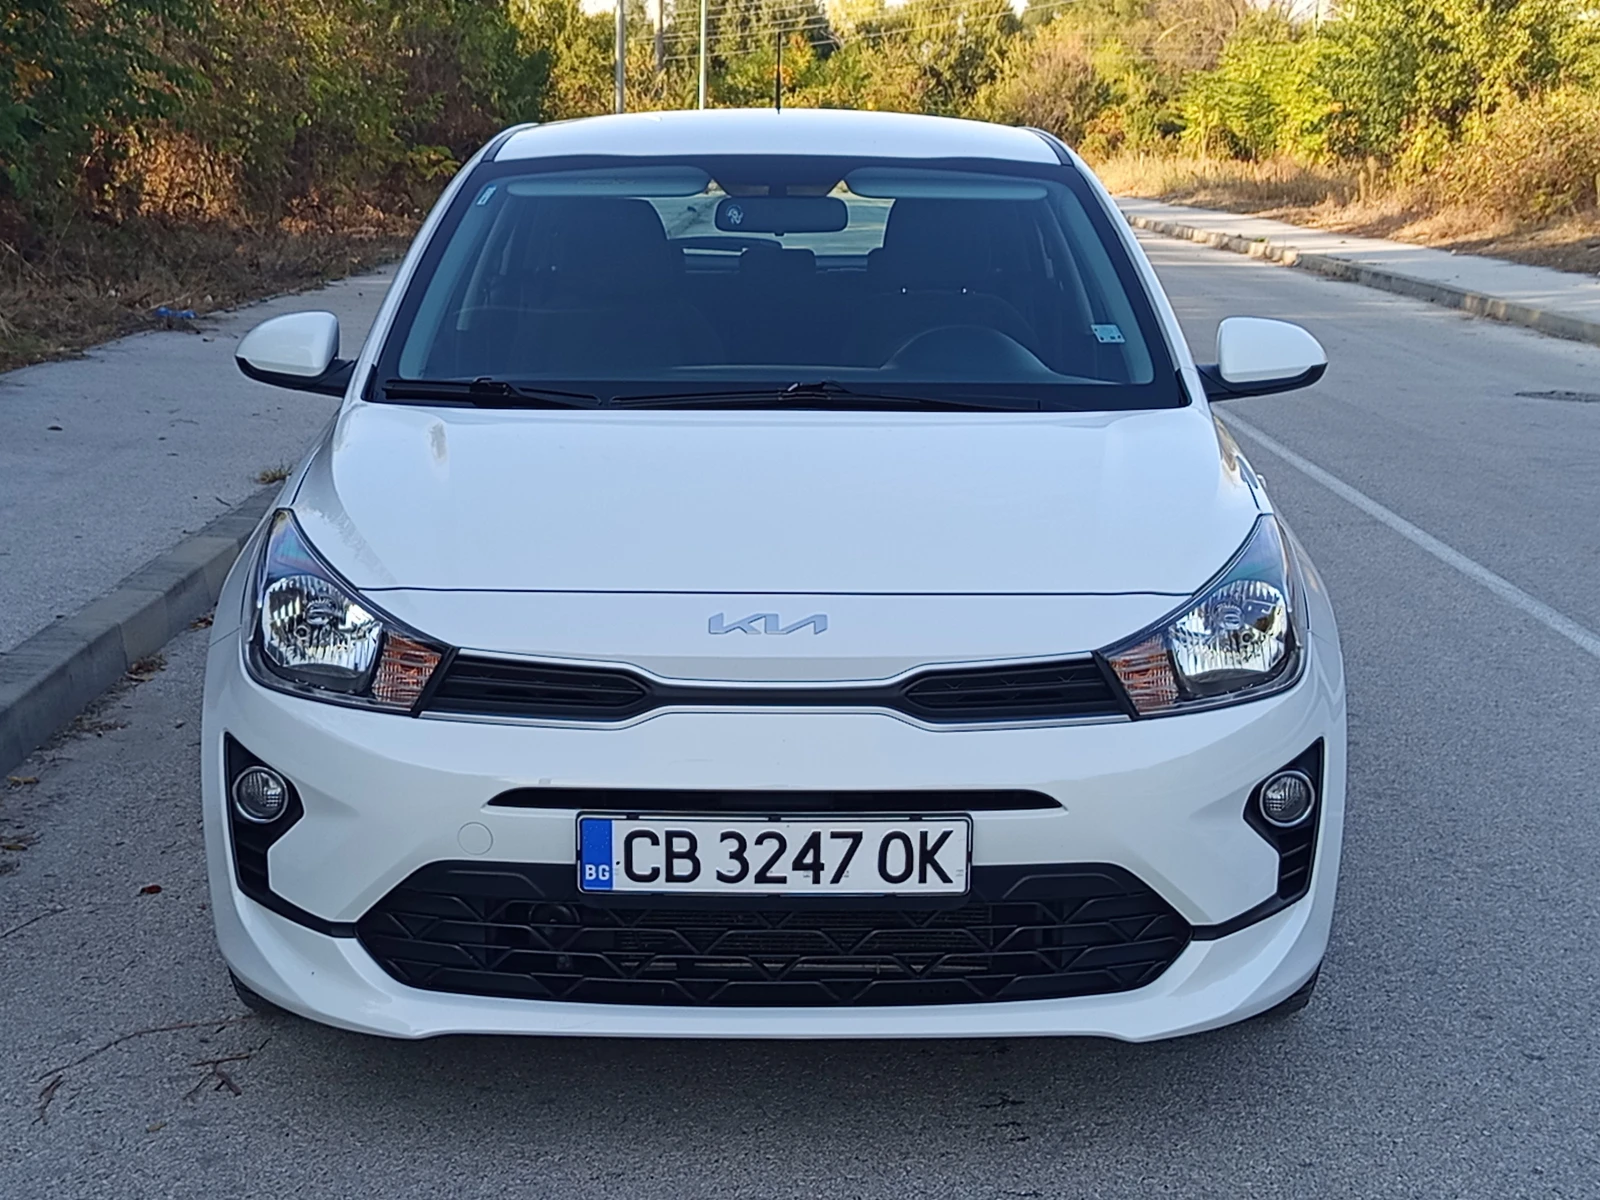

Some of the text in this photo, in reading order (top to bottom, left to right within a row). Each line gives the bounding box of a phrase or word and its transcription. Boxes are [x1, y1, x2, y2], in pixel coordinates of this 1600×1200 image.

[708, 612, 828, 635] KIA
[623, 829, 954, 885] CB 3247 OK
[584, 865, 610, 880] BG
